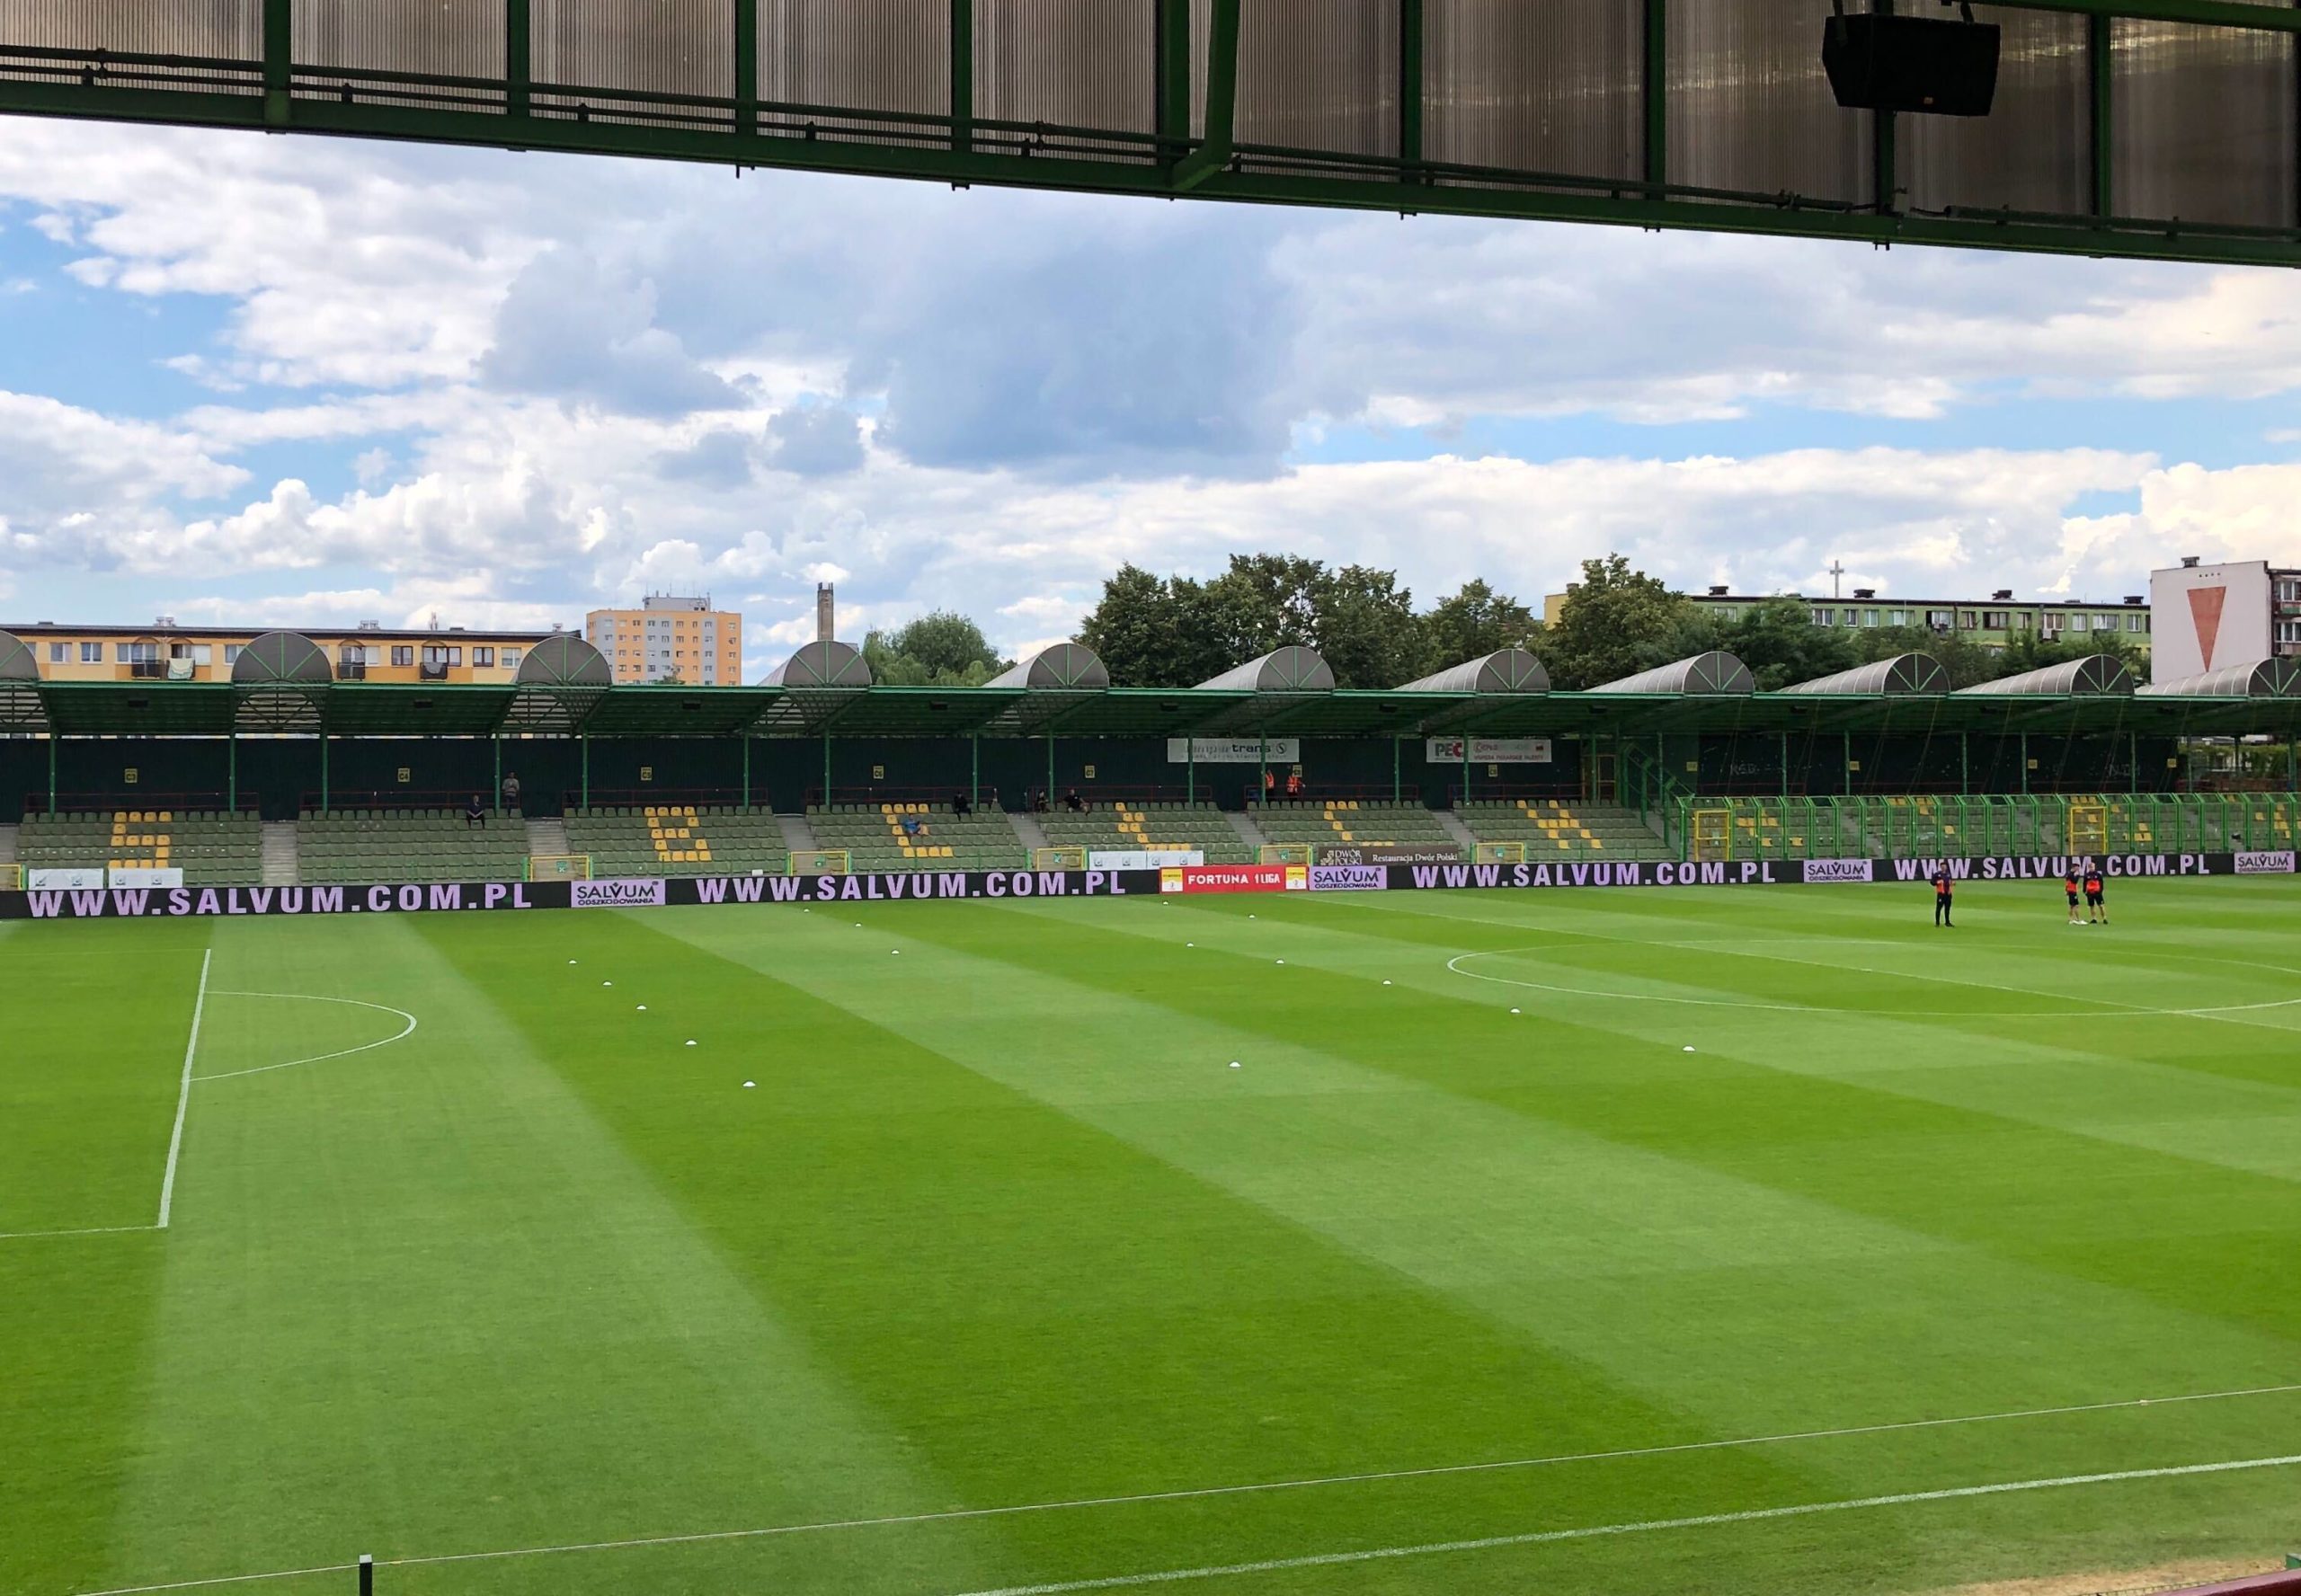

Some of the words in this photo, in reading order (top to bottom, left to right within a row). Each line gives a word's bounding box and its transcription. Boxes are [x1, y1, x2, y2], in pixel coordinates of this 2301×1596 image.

[1435, 741, 1463, 758] PEC
[1373, 854, 1413, 864] Restauracja
[1415, 853, 1435, 862] Dwór
[1436, 852, 1458, 861] Polski
[2238, 854, 2288, 866] SALVUM
[1314, 868, 1379, 882] SALVUM
[1411, 862, 1777, 889] WWW.SALVUM.COM.PL
[1808, 862, 1865, 875] SALVUM
[1894, 855, 2210, 881] WWW.SALVUM.COM.PL
[1188, 874, 1248, 884] FORTUNA
[577, 882, 656, 899] SALVUM
[695, 871, 1126, 903] WWW.SALVUM.COM.PL
[26, 883, 532, 918] WWW.SALVUM.COM.PL
[578, 898, 654, 906] ODSZKODOWANIA
